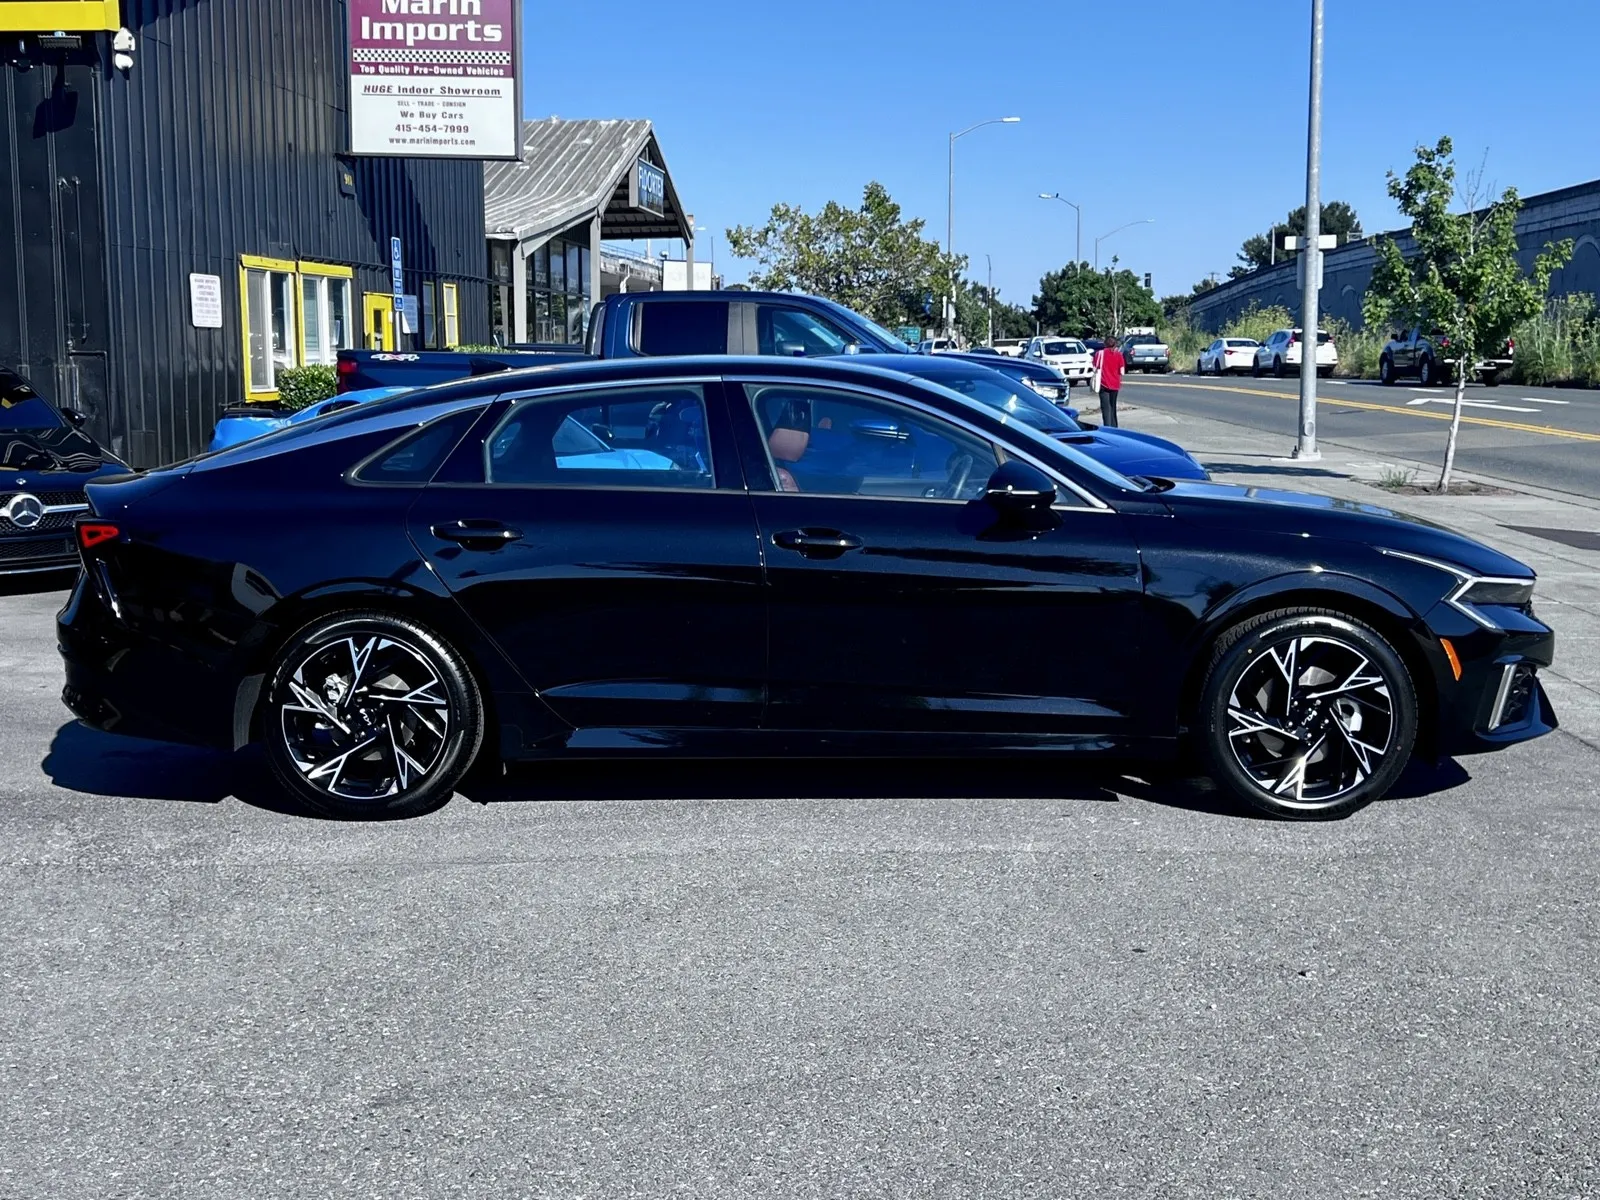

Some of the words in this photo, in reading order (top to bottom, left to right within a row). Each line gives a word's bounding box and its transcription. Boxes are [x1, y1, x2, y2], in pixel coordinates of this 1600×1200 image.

[382, 0, 481, 15] Marin
[361, 16, 502, 46] Imports
[360, 65, 375, 74] Top
[378, 65, 410, 75] Quality
[413, 65, 463, 75] Pre-Owned
[466, 66, 504, 76] Vehicles
[363, 85, 393, 93] HUGE
[398, 85, 435, 94] Indoor
[440, 86, 501, 95] Showroom
[400, 110, 415, 118] We
[419, 111, 437, 120] Buy
[441, 111, 464, 119] Cars
[395, 124, 469, 134] 415-454-7999
[389, 137, 476, 146] www.marinimports.com
